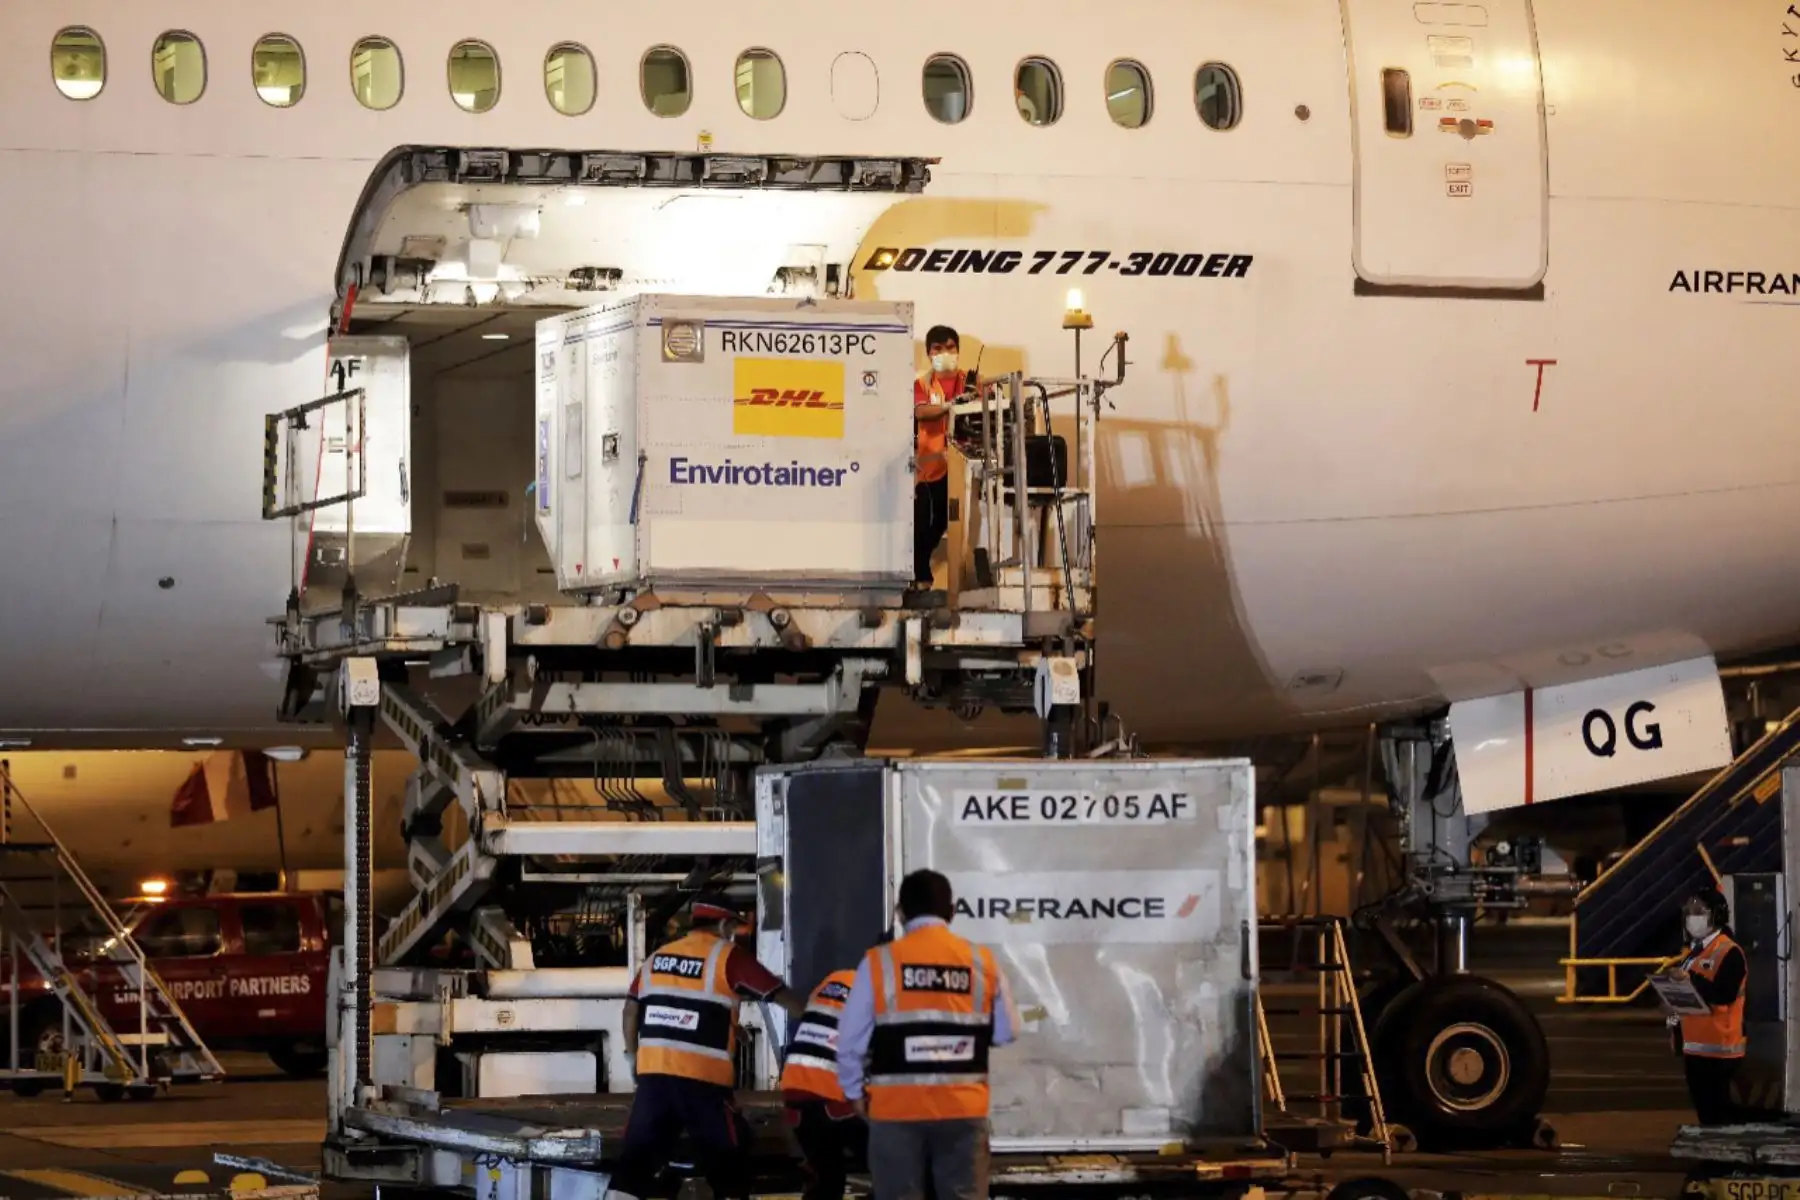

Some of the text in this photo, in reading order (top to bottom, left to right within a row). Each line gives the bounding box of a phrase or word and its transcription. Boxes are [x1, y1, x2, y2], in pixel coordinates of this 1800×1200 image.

[1449, 184, 1469, 193] EXIT
[862, 247, 1254, 278] BOEING 777-300ER
[721, 331, 877, 355] RKN62613PC
[749, 388, 829, 409] DHL
[1582, 700, 1663, 758] QG
[961, 795, 1031, 820] AKE
[954, 897, 1166, 919] AIRFRANCE
[653, 955, 703, 976] SGP-077
[229, 974, 311, 998] PARTNERS
[903, 967, 970, 991] SGP-109
